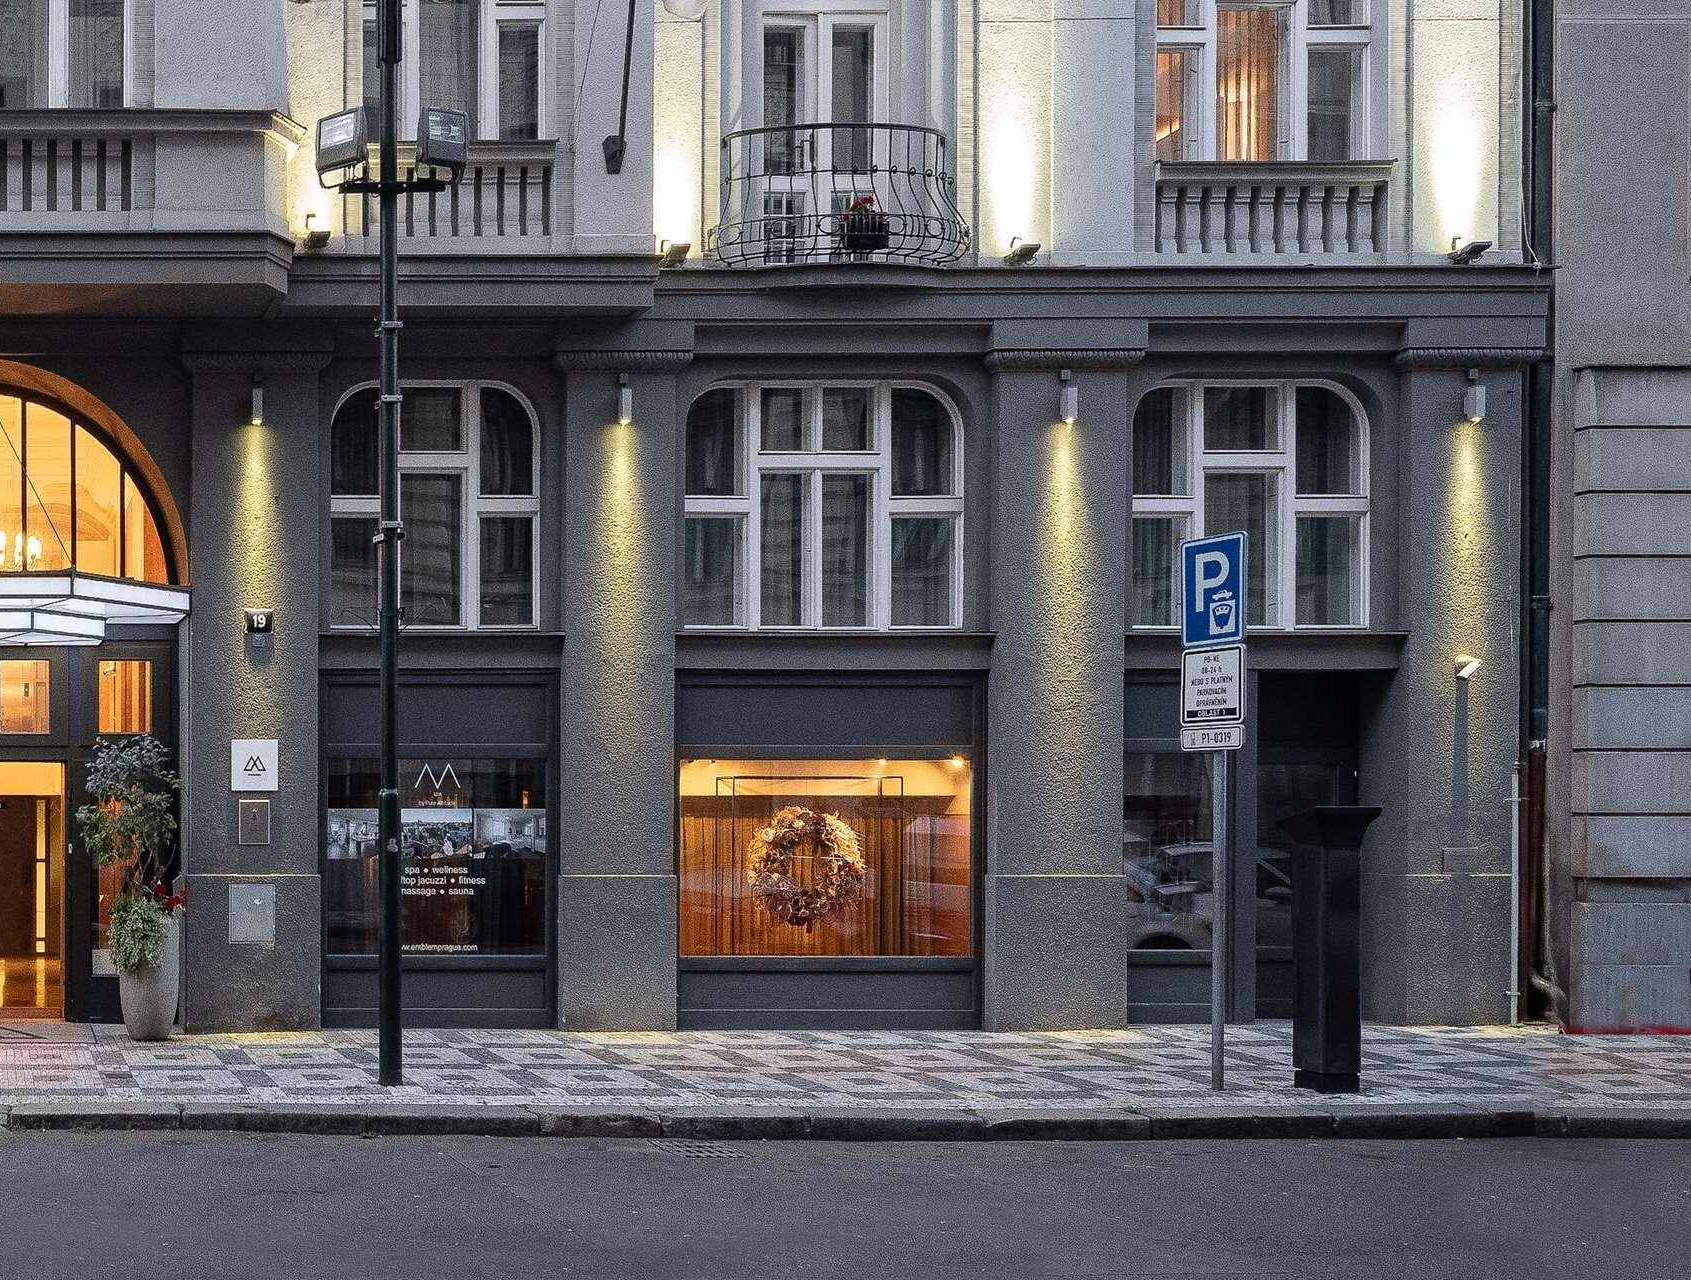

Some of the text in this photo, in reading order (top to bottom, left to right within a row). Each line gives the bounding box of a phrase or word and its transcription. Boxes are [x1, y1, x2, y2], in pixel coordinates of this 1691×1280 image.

[1195, 551, 1230, 613] P
[252, 614, 266, 628] 19
[1201, 731, 1231, 744] P1-0319
[404, 865, 469, 875] spa wellness
[417, 876, 447, 886] jacuzzi
[458, 875, 487, 885] fitness
[448, 887, 475, 895] sauna
